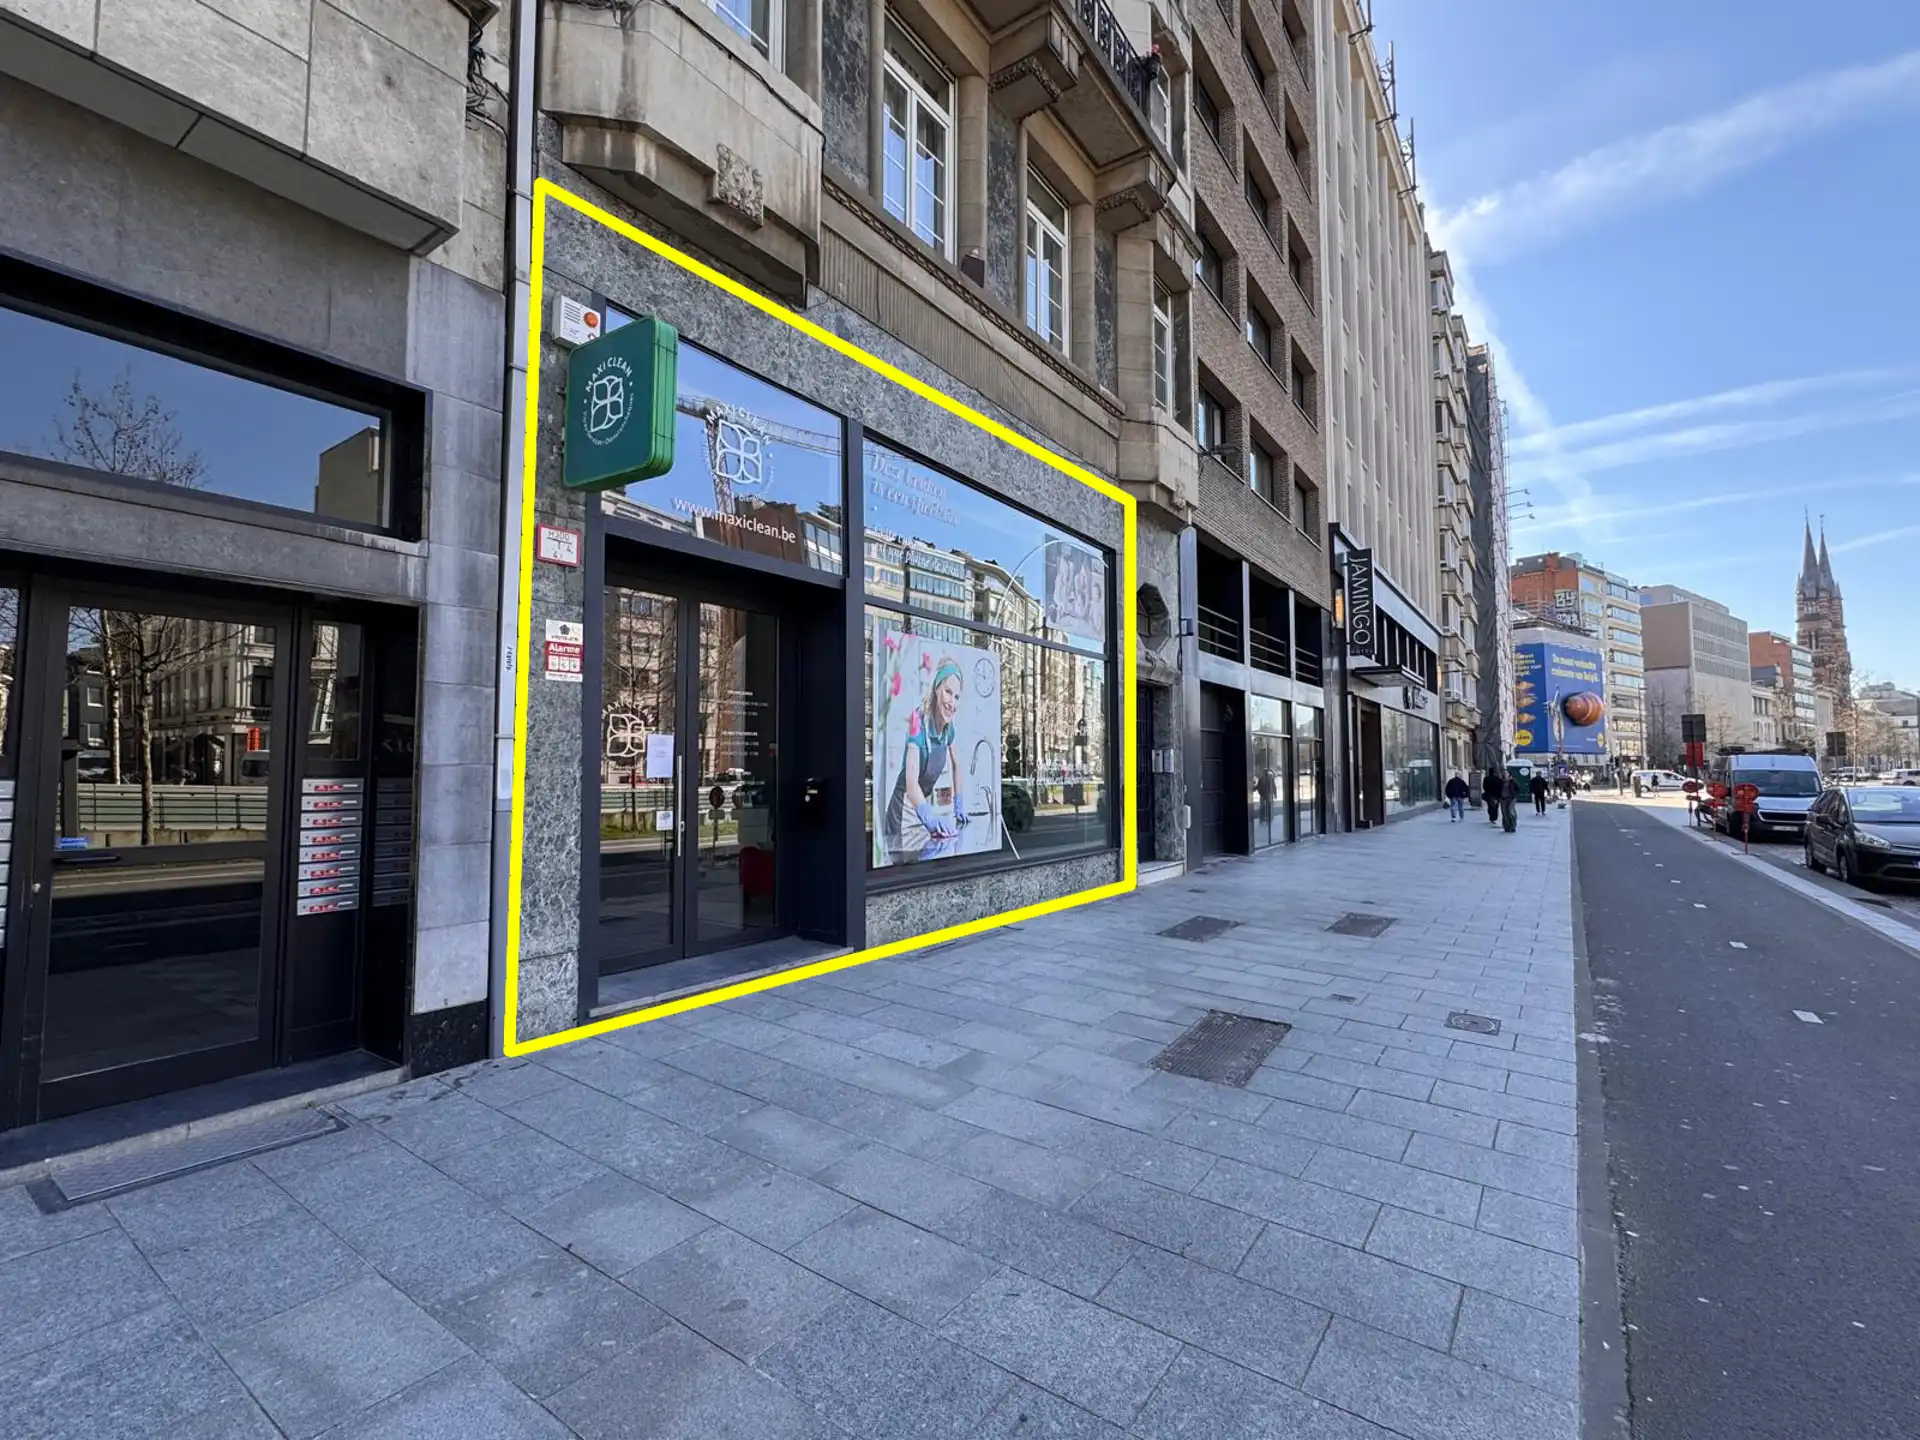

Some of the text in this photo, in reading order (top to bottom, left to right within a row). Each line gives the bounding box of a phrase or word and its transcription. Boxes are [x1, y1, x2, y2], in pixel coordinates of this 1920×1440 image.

[671, 497, 797, 544] www.maxiclean.be
[1348, 557, 1371, 645] JAMINGO
[549, 642, 581, 654] Alarme
